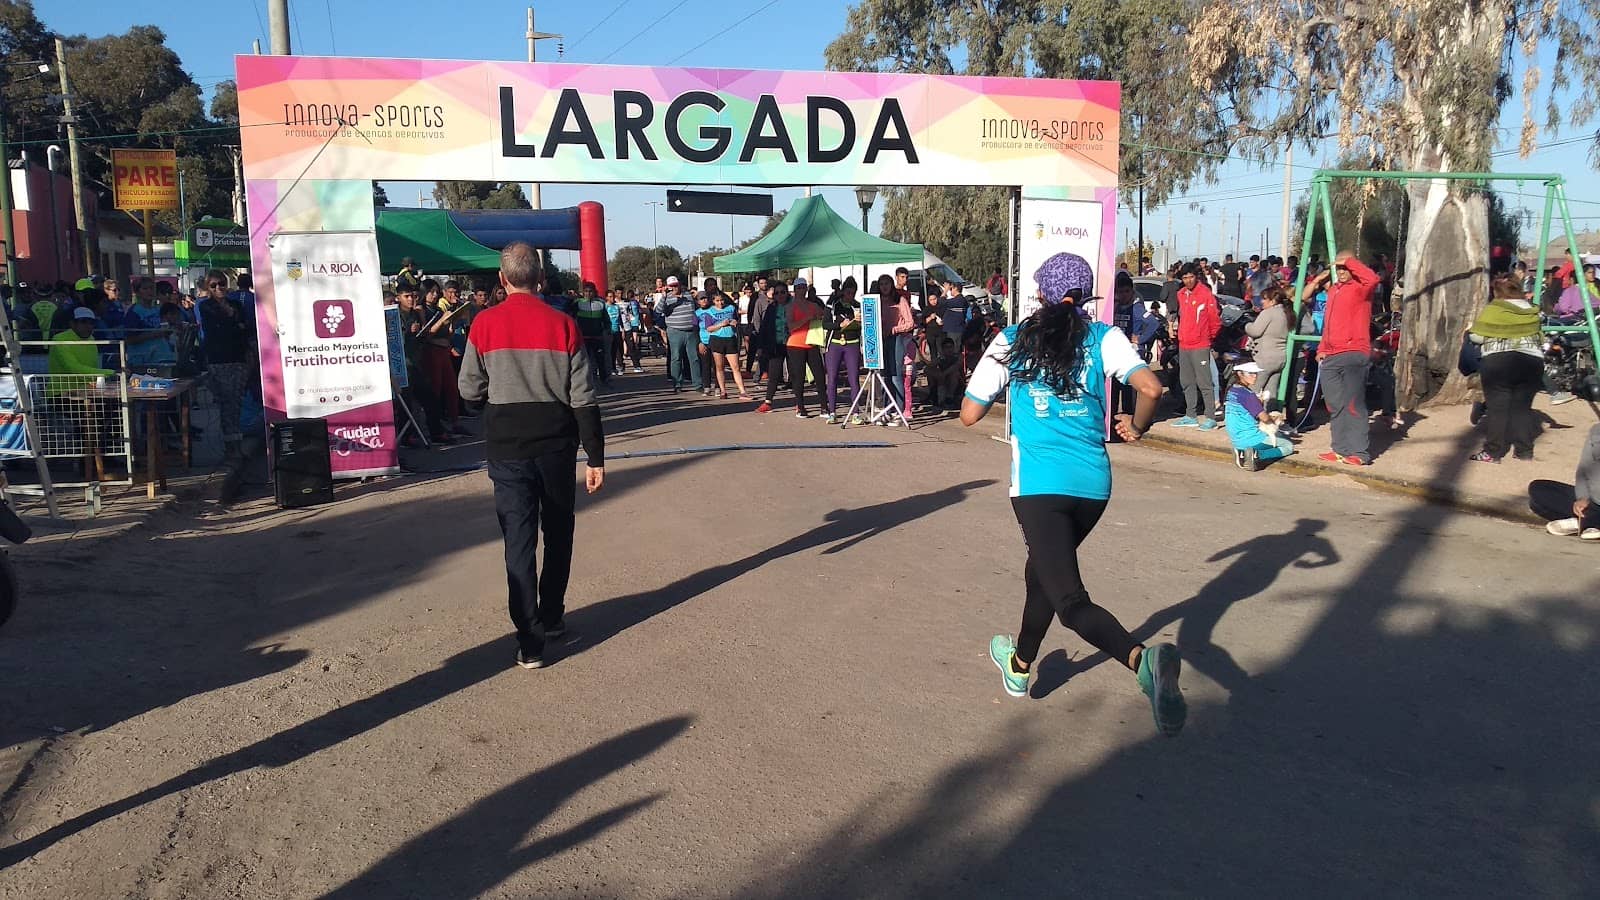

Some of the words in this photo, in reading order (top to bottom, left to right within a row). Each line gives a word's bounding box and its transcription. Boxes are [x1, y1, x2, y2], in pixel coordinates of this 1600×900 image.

[498, 85, 920, 164] LARGADA
[114, 165, 175, 187] PARE
[1051, 226, 1063, 236] LA
[1064, 226, 1089, 239] RIOJA
[312, 263, 328, 274] LA
[330, 263, 364, 277] RIOJA
[287, 345, 330, 353] Mercado
[333, 342, 379, 352] Mayorista
[284, 352, 385, 367] Frutihortícola
[334, 423, 380, 440] Ciudad
